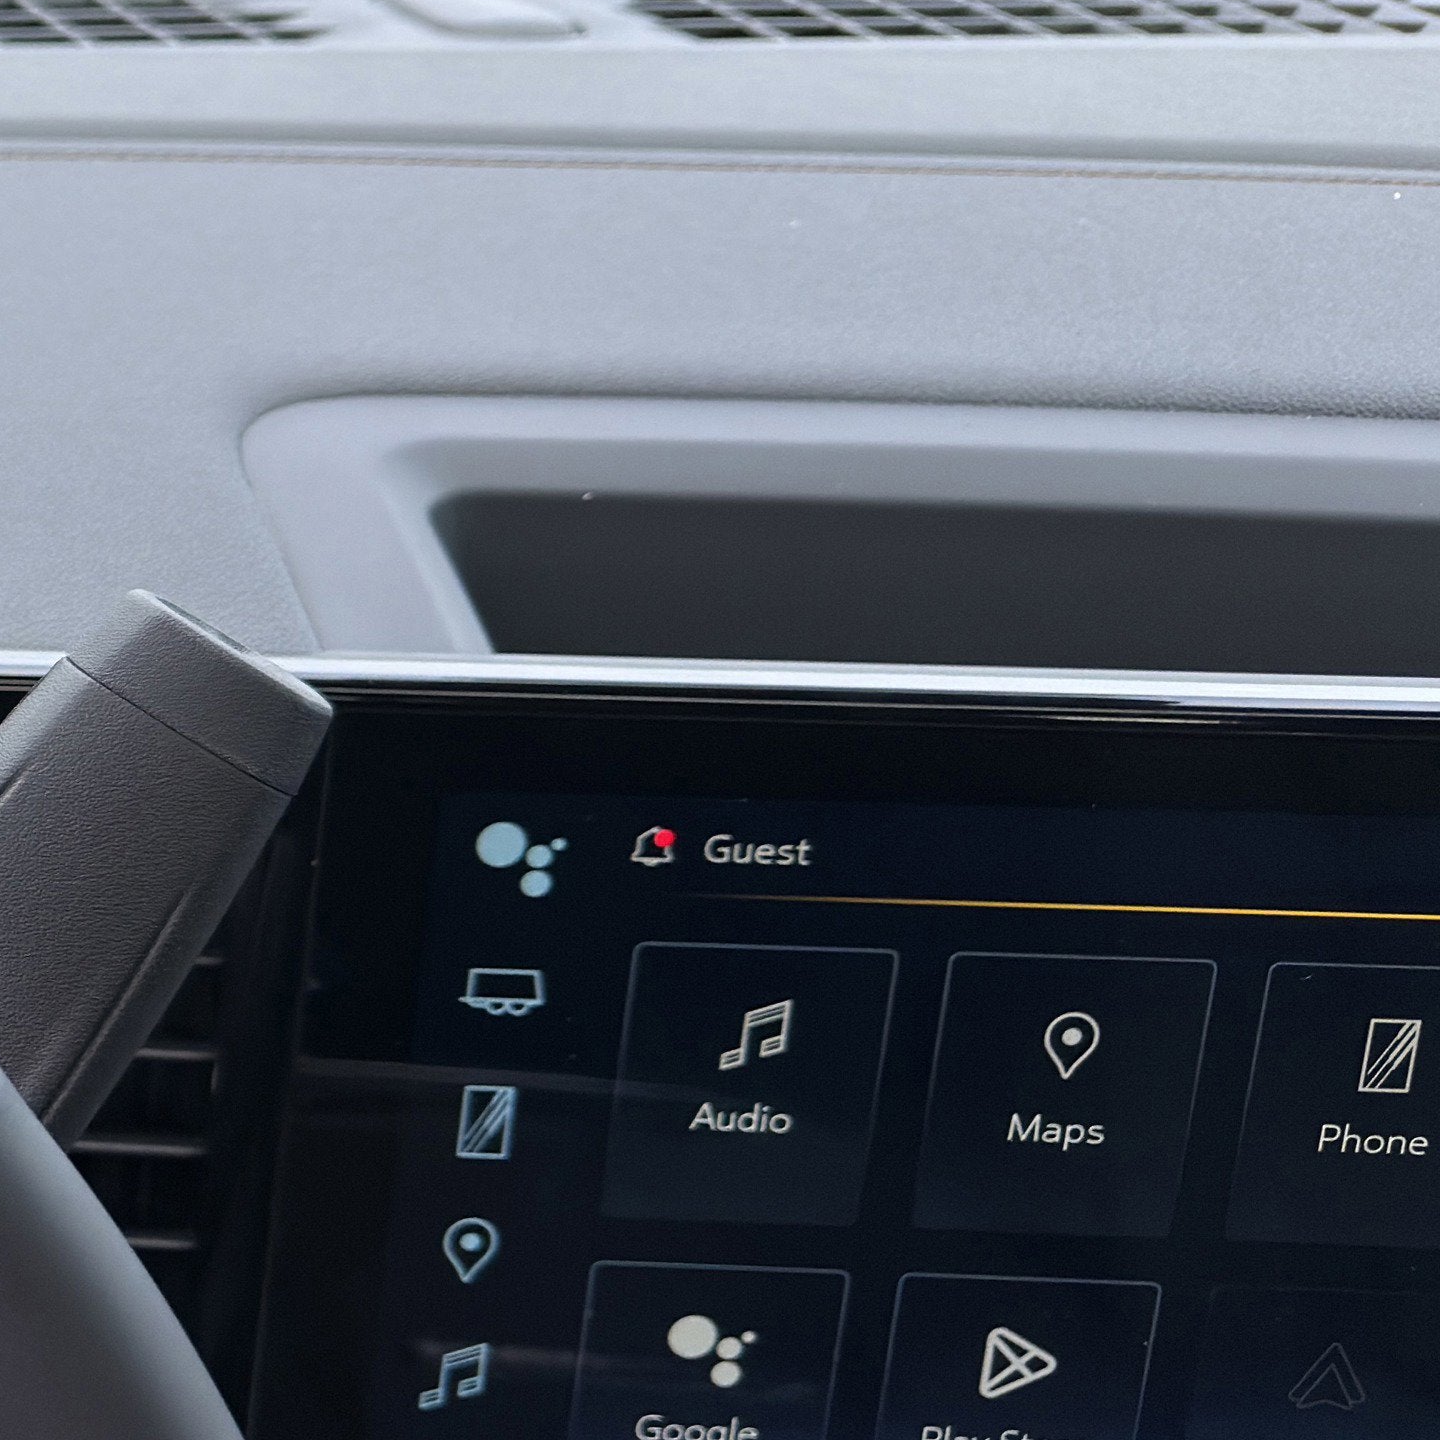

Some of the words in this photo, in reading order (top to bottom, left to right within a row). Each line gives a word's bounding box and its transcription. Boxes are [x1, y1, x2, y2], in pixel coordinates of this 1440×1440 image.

[703, 833, 812, 867] Guest
[688, 1101, 793, 1135] Audio
[1006, 1112, 1106, 1152] Maps
[1317, 1123, 1429, 1157] Phone
